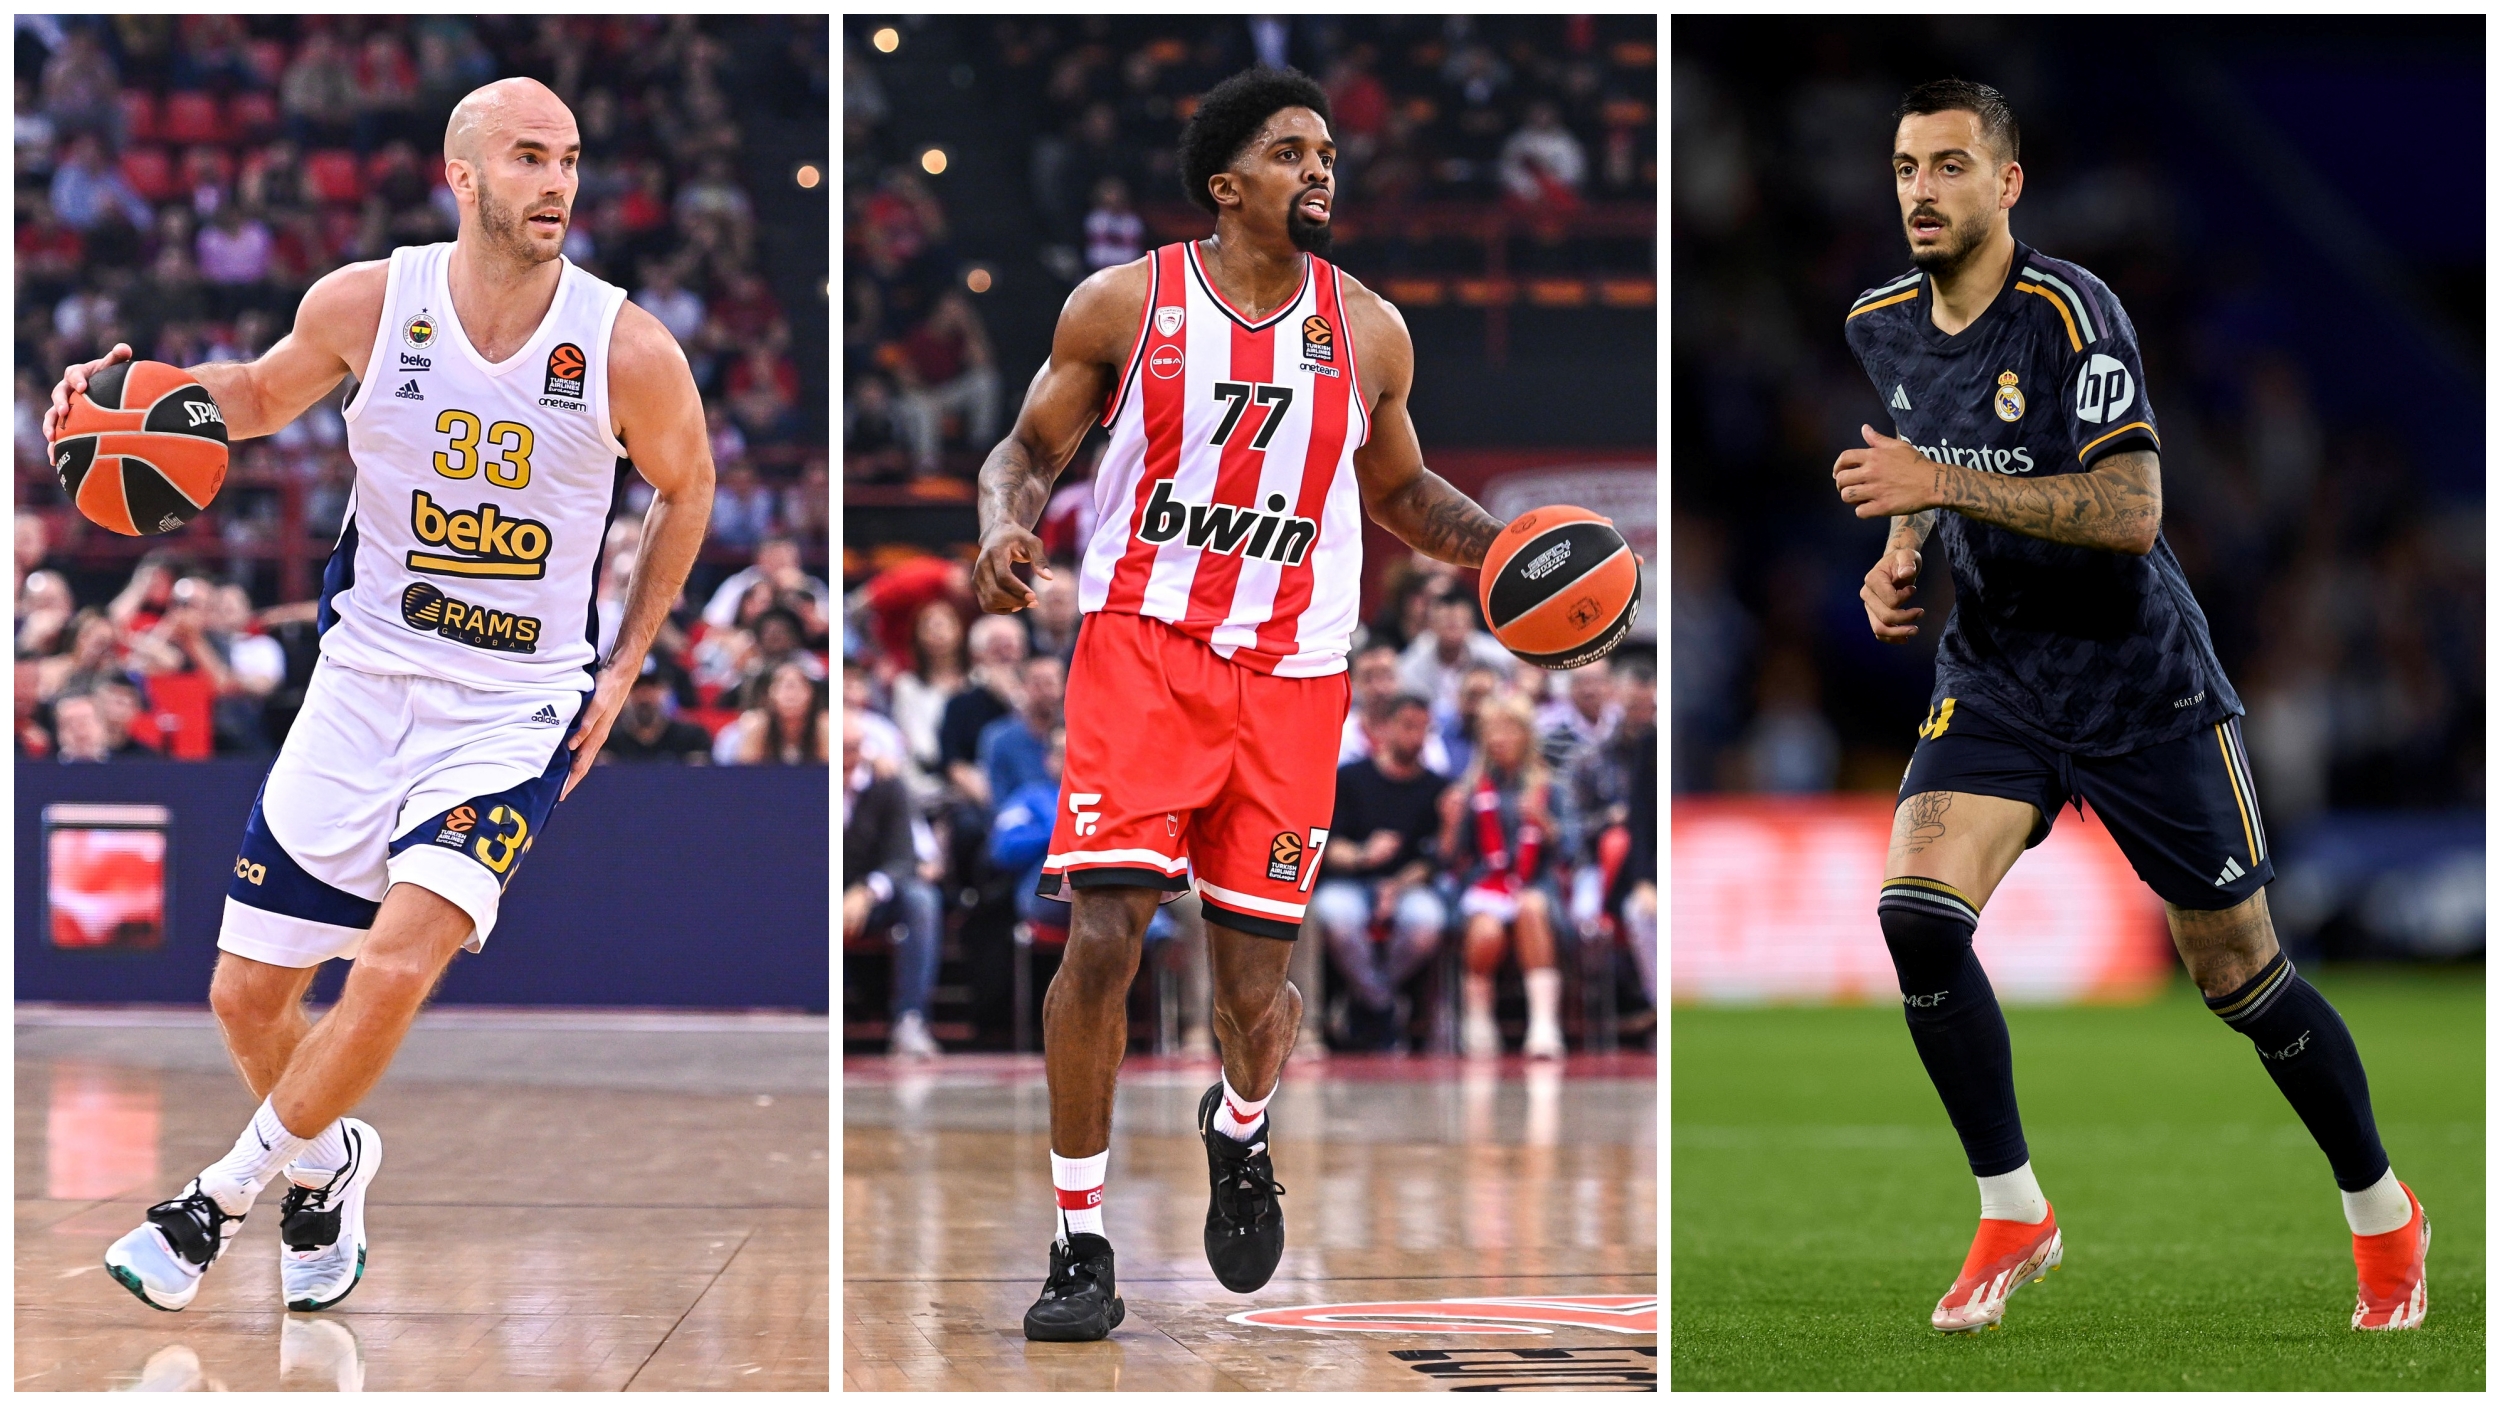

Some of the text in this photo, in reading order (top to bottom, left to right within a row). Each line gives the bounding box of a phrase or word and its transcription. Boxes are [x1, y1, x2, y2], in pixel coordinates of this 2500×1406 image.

[400, 352, 432, 368] beko
[395, 390, 424, 401] adidas
[549, 382, 581, 391] AIRLINES
[550, 377, 581, 386] TURKISH
[2078, 353, 2126, 424] hp
[183, 400, 226, 427] SPAL
[1208, 381, 1295, 449] 77
[432, 408, 535, 490] 33
[1900, 434, 2036, 475] mirates
[412, 490, 551, 563] beko
[1138, 480, 1317, 565] bwin
[443, 601, 537, 642] RAMS
[441, 627, 532, 651] GLOBAL
[531, 715, 560, 726] adidas
[474, 804, 533, 896] 3
[233, 854, 267, 886] ca
[1270, 867, 1297, 876] AIRLINES
[1271, 861, 1298, 871] TURKISH
[2256, 1029, 2311, 1061] MCF
[1086, 1189, 1103, 1206] GS
